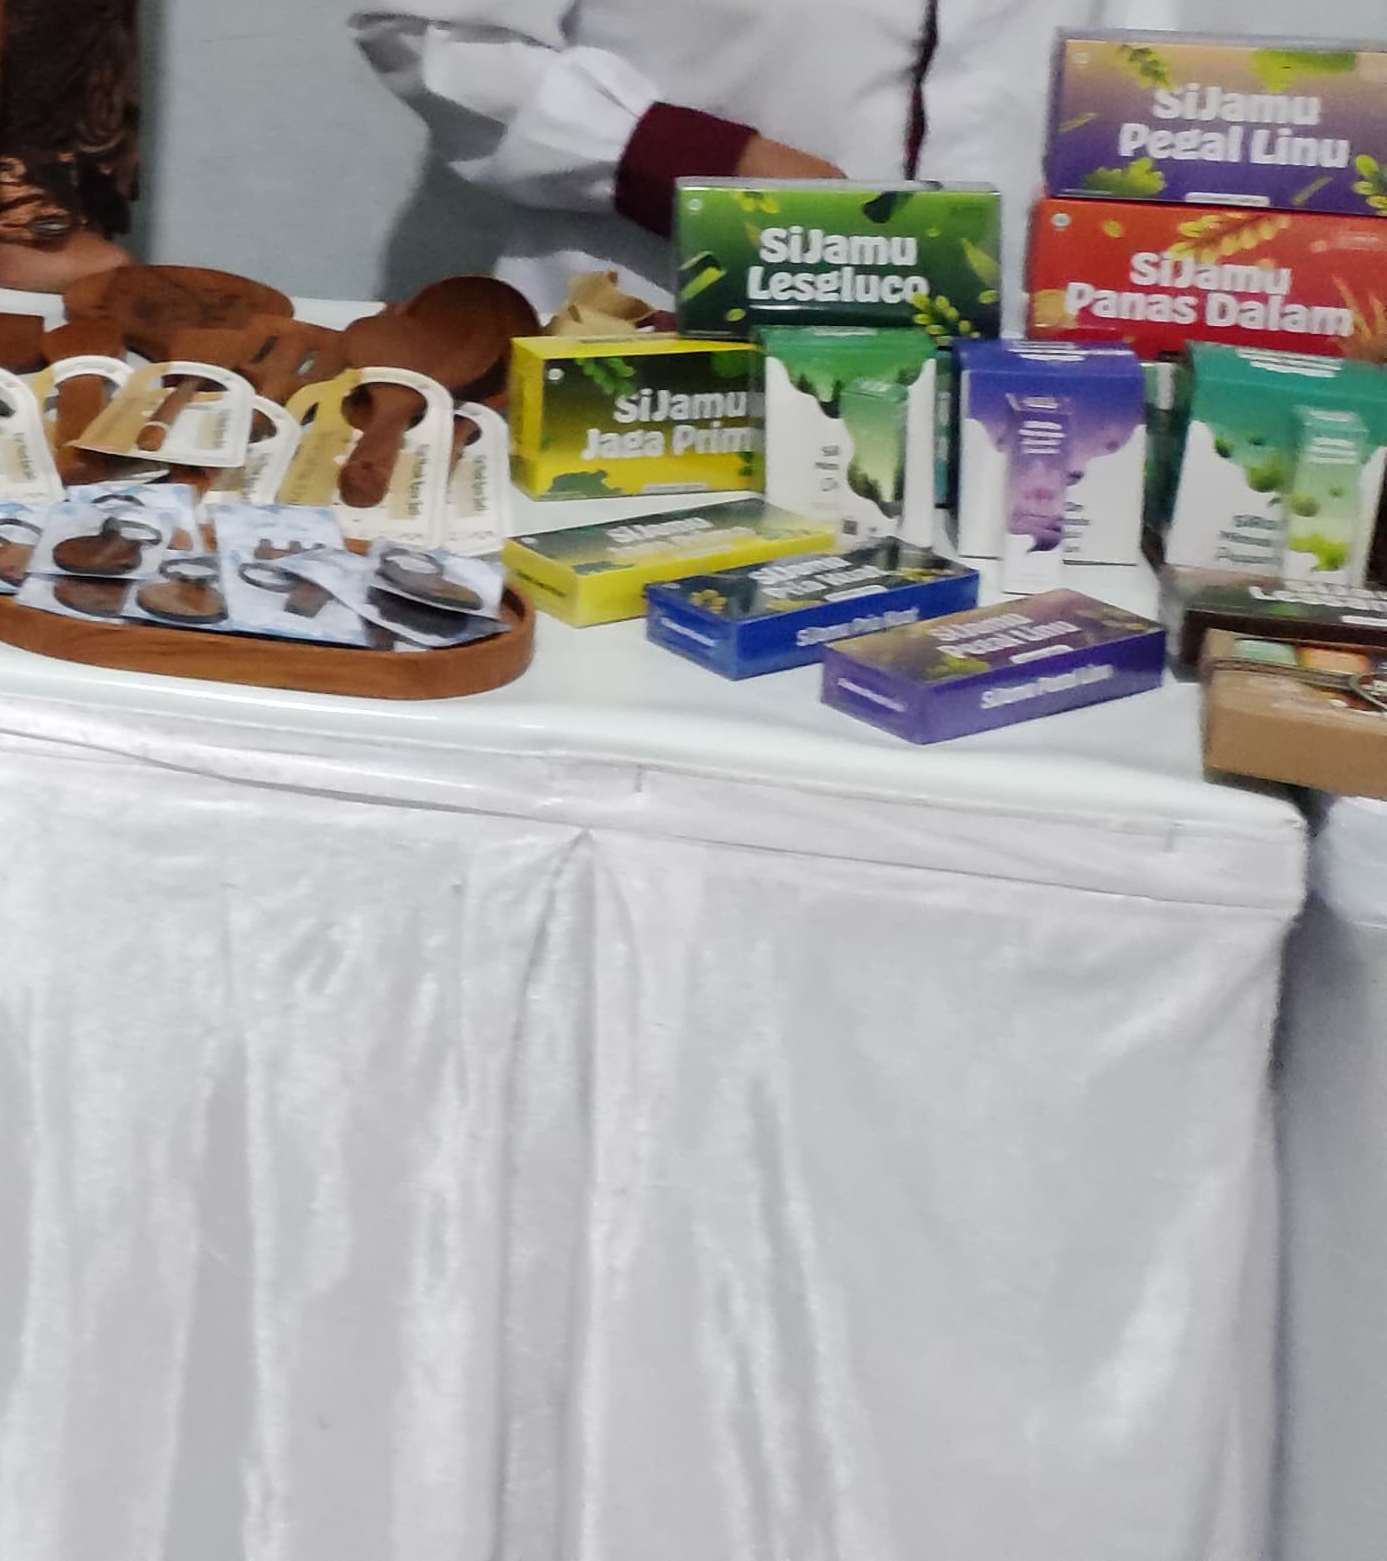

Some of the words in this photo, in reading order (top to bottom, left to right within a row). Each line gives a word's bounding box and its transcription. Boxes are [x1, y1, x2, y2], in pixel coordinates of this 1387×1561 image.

[1151, 83, 1322, 125] SiJamu
[1118, 123, 1244, 162] Pegal
[1250, 128, 1351, 168] Linu
[759, 225, 918, 266] SiJamu
[747, 265, 930, 303] Lesgluco
[1130, 251, 1292, 294] SiJamu
[1065, 281, 1198, 325] Panas
[1204, 292, 1355, 336] Dalam
[613, 388, 748, 423] SiJamu
[581, 428, 665, 460] Jaga
[672, 420, 755, 455] Prim
